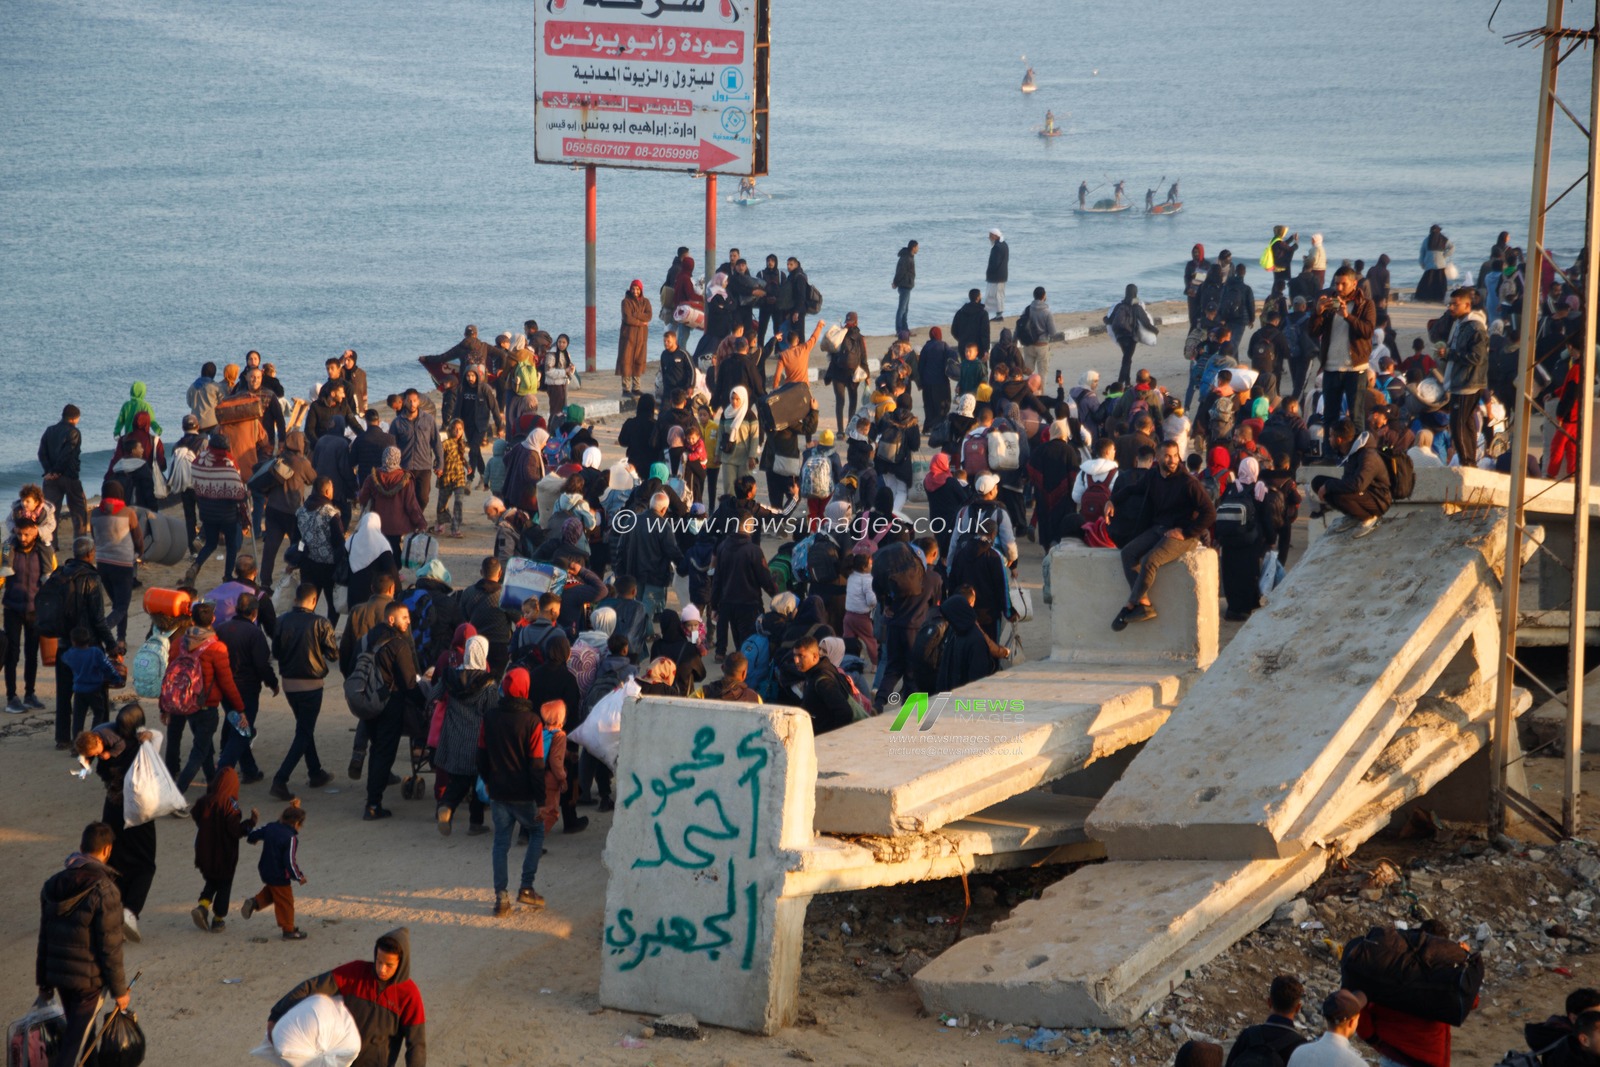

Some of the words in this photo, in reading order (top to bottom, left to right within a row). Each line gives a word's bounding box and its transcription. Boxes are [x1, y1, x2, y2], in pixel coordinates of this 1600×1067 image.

[550, 26, 621, 55] يونس
[624, 28, 677, 57] وأبو
[681, 32, 739, 59] عودة
[573, 65, 621, 85] المعدنية
[623, 66, 669, 87] والزيوت
[672, 68, 715, 89] للبترول
[642, 99, 690, 115] خانيونس
[581, 117, 610, 133] يونس
[565, 142, 631, 157] 0595607107
[635, 146, 699, 160] 08-2059996
